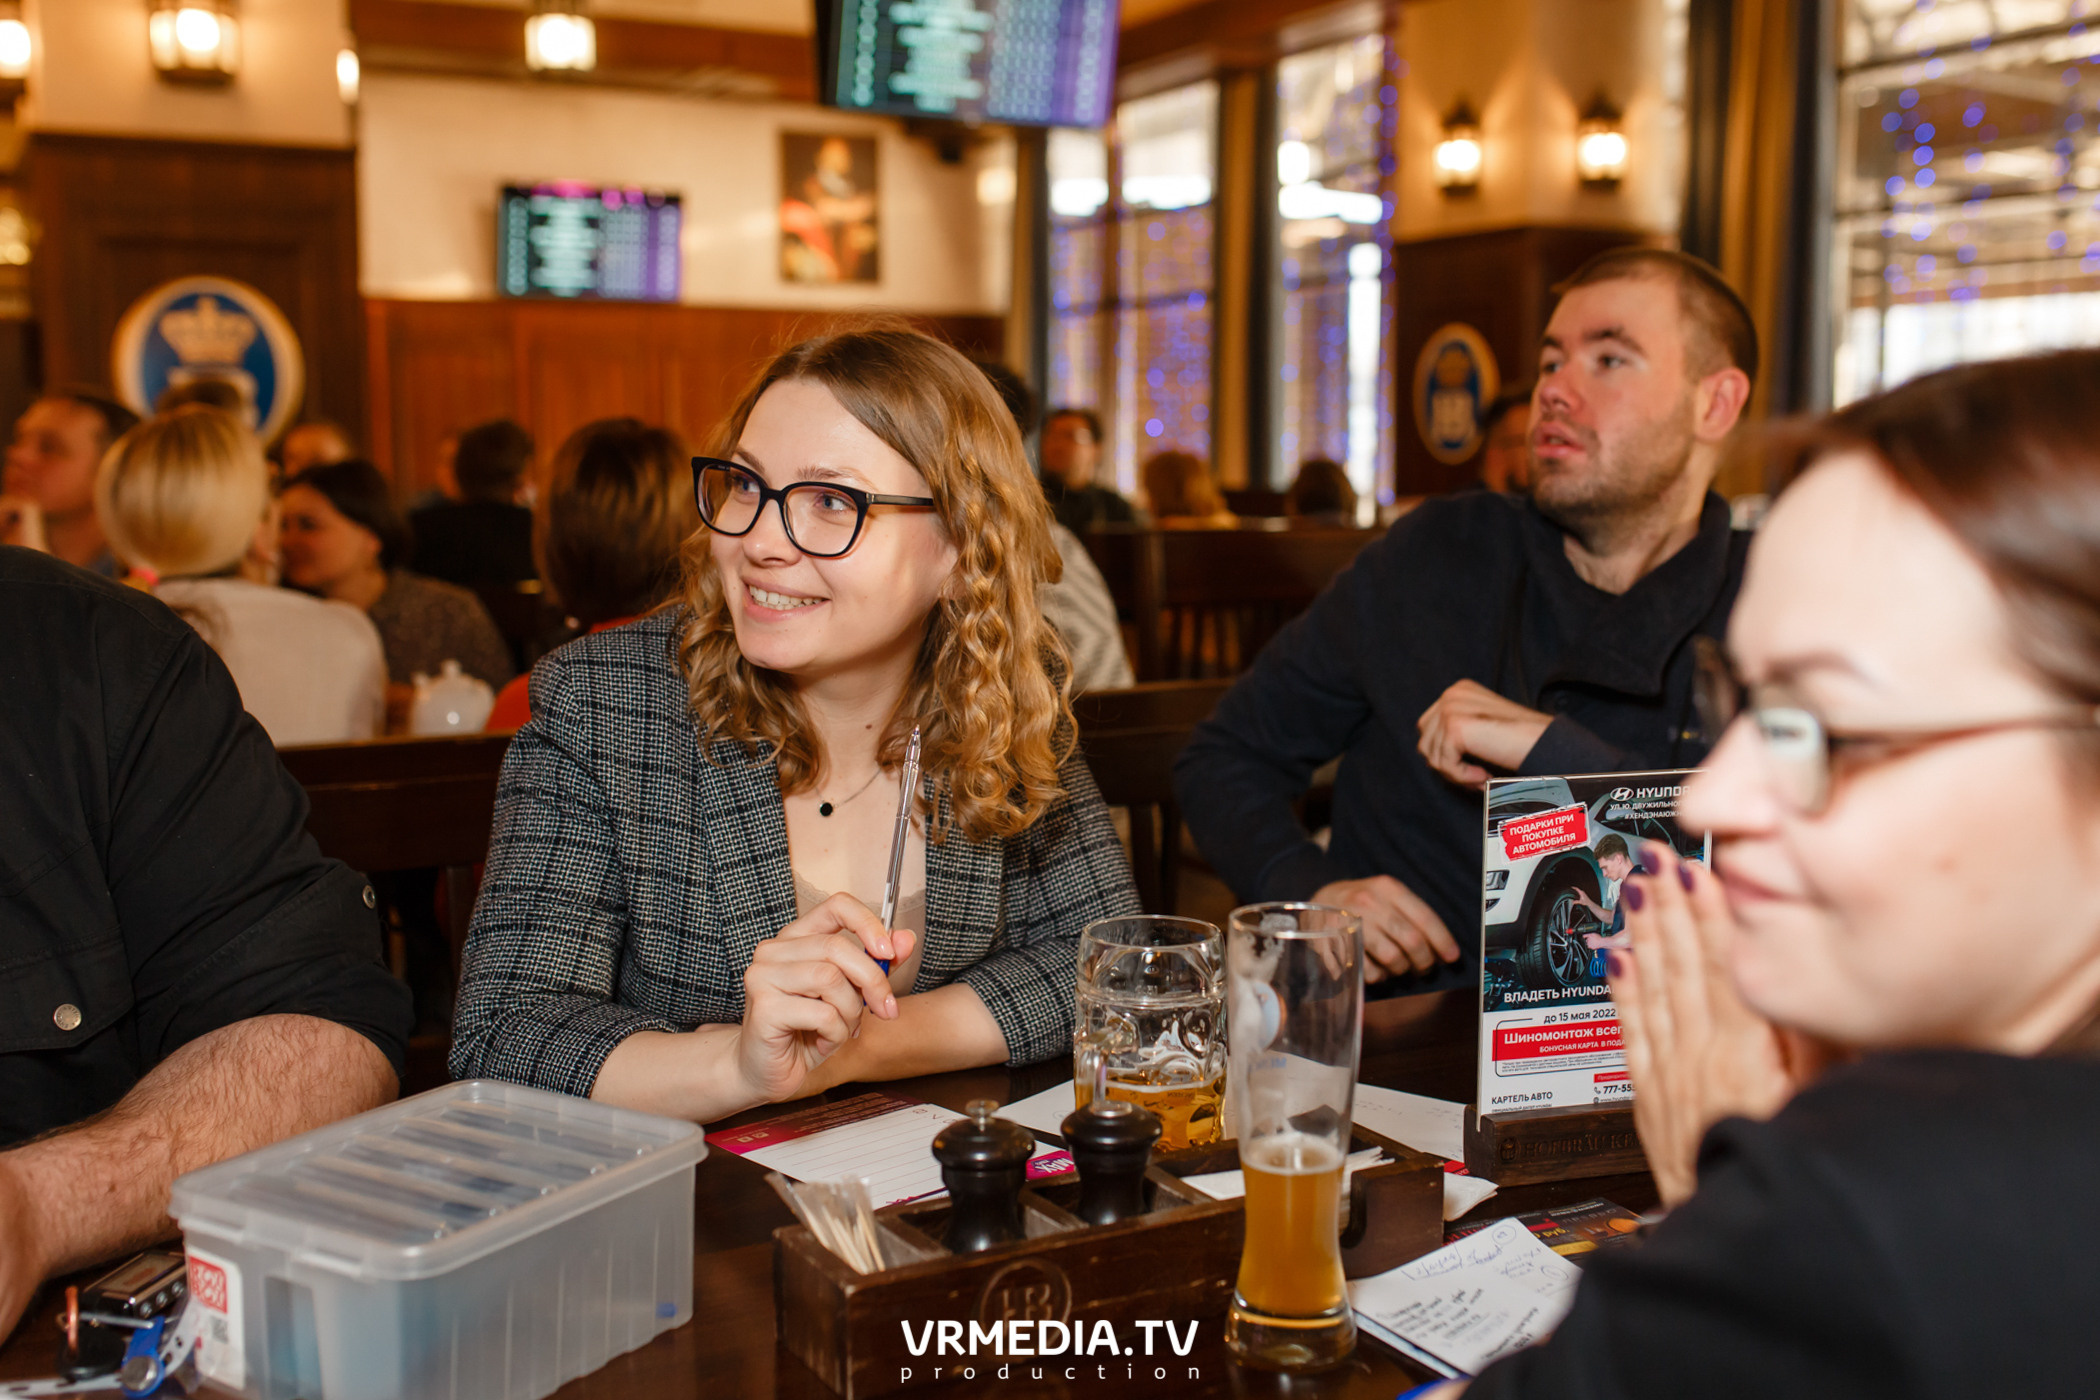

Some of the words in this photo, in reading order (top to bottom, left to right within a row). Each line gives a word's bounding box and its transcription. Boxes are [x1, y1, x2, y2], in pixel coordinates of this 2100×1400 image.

[1509, 819, 1553, 836] ПОДАРКИ
[1555, 814, 1574, 825] ПРИ
[1521, 825, 1565, 842] ПОКУПКЕ
[1512, 833, 1576, 854] АВТОМОБИЛЯ
[1504, 989, 1560, 1004] ВЛАДЕТЬ
[1543, 1015, 1557, 1024] до
[1558, 1012, 1569, 1021] 15
[1570, 1010, 1590, 1020] мая
[1592, 1008, 1616, 1019] 2022
[1504, 1028, 1593, 1044] Шиномонтаж
[1539, 1042, 1576, 1053] БОНУСНАЯ
[1577, 1040, 1599, 1049] КАРТА
[1600, 1040, 1606, 1048] В
[1491, 1093, 1530, 1105] КАРТЕЛЬ
[1530, 1091, 1553, 1101] АВТО
